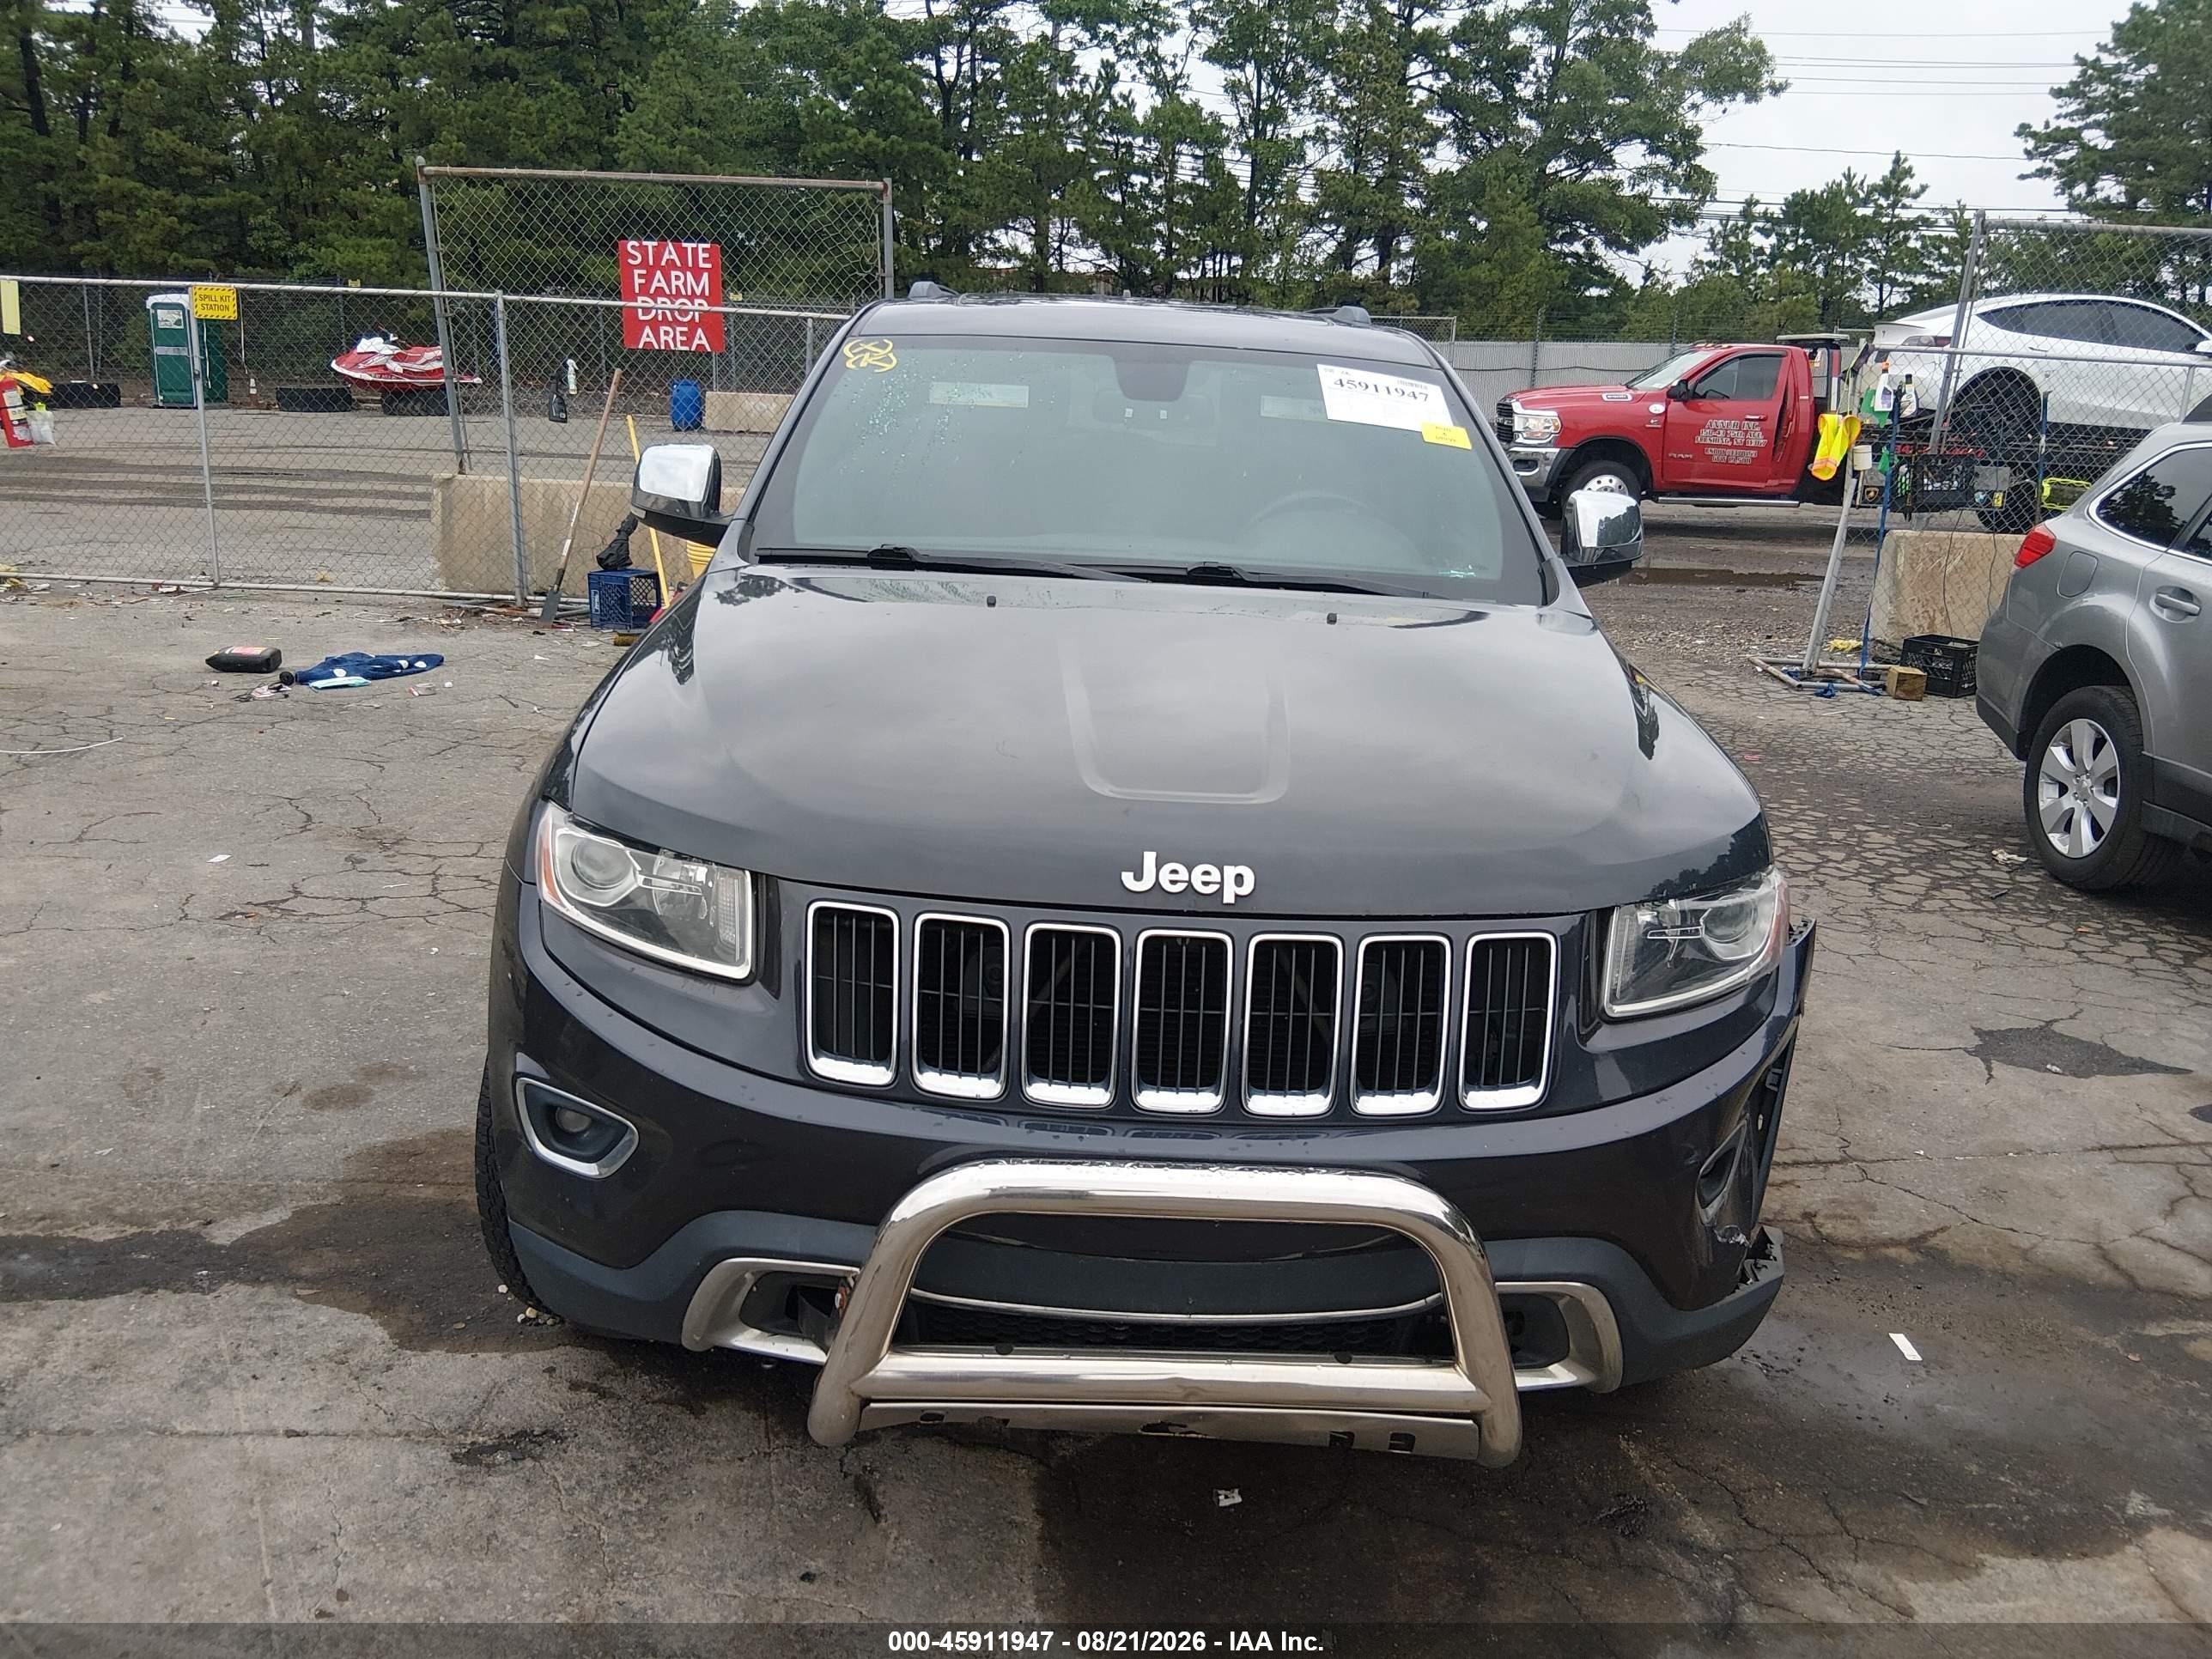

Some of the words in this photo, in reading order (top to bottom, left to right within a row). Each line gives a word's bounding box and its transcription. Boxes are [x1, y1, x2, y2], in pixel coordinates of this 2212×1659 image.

[627, 240, 712, 269] STATE
[634, 269, 709, 296] FARM
[200, 303, 230, 312] STATION
[637, 296, 708, 323] DROP
[638, 325, 712, 352] AREA
[1334, 378, 1430, 402] 45911947
[1121, 851, 1255, 904] Jeep
